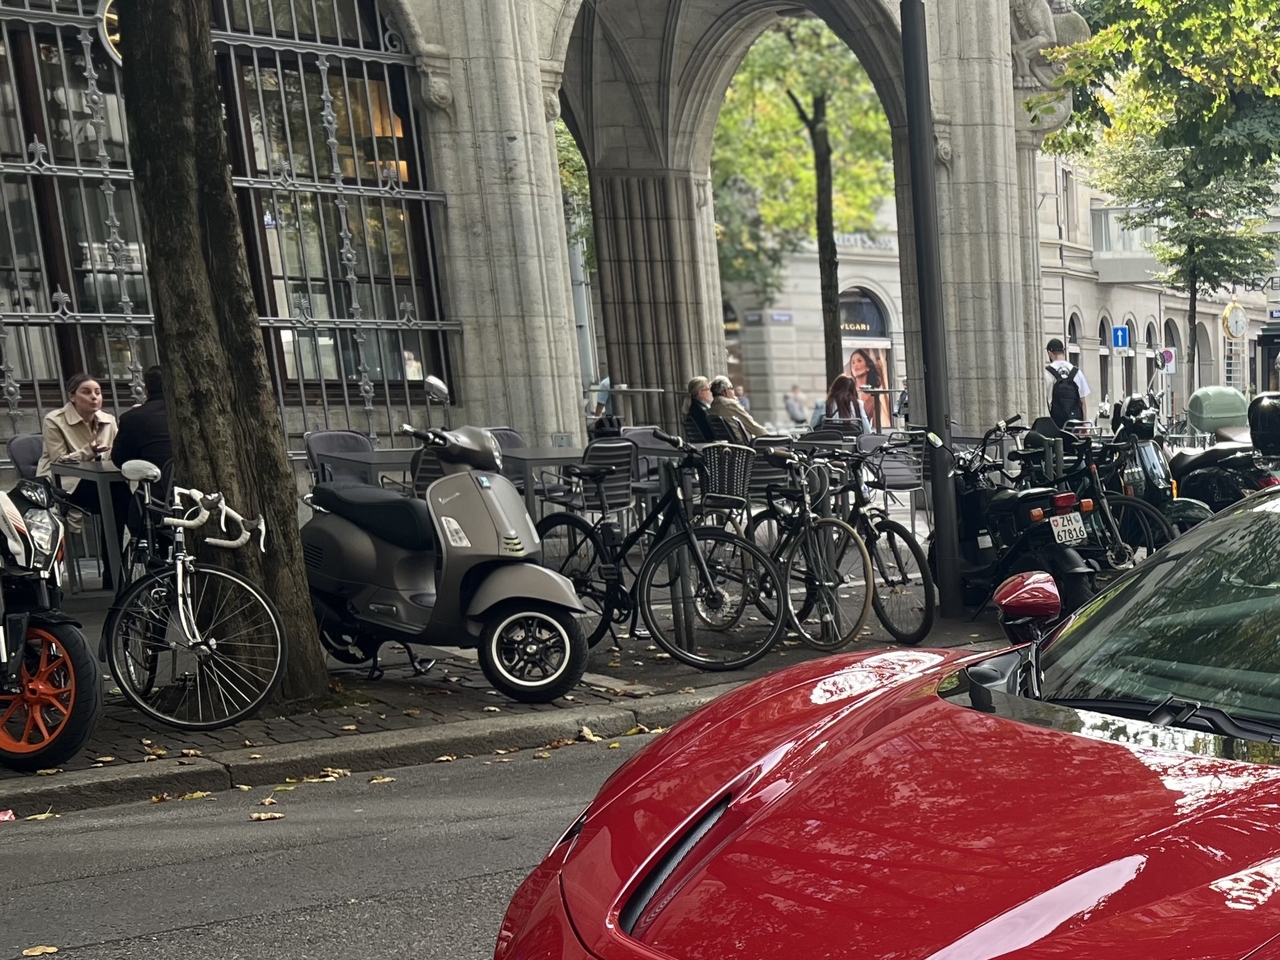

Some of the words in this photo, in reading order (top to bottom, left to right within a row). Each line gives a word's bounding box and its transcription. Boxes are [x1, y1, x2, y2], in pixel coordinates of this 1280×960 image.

[840, 323, 870, 331] VLGARI
[1060, 516, 1073, 527] ZH
[1057, 526, 1085, 541] 67816
